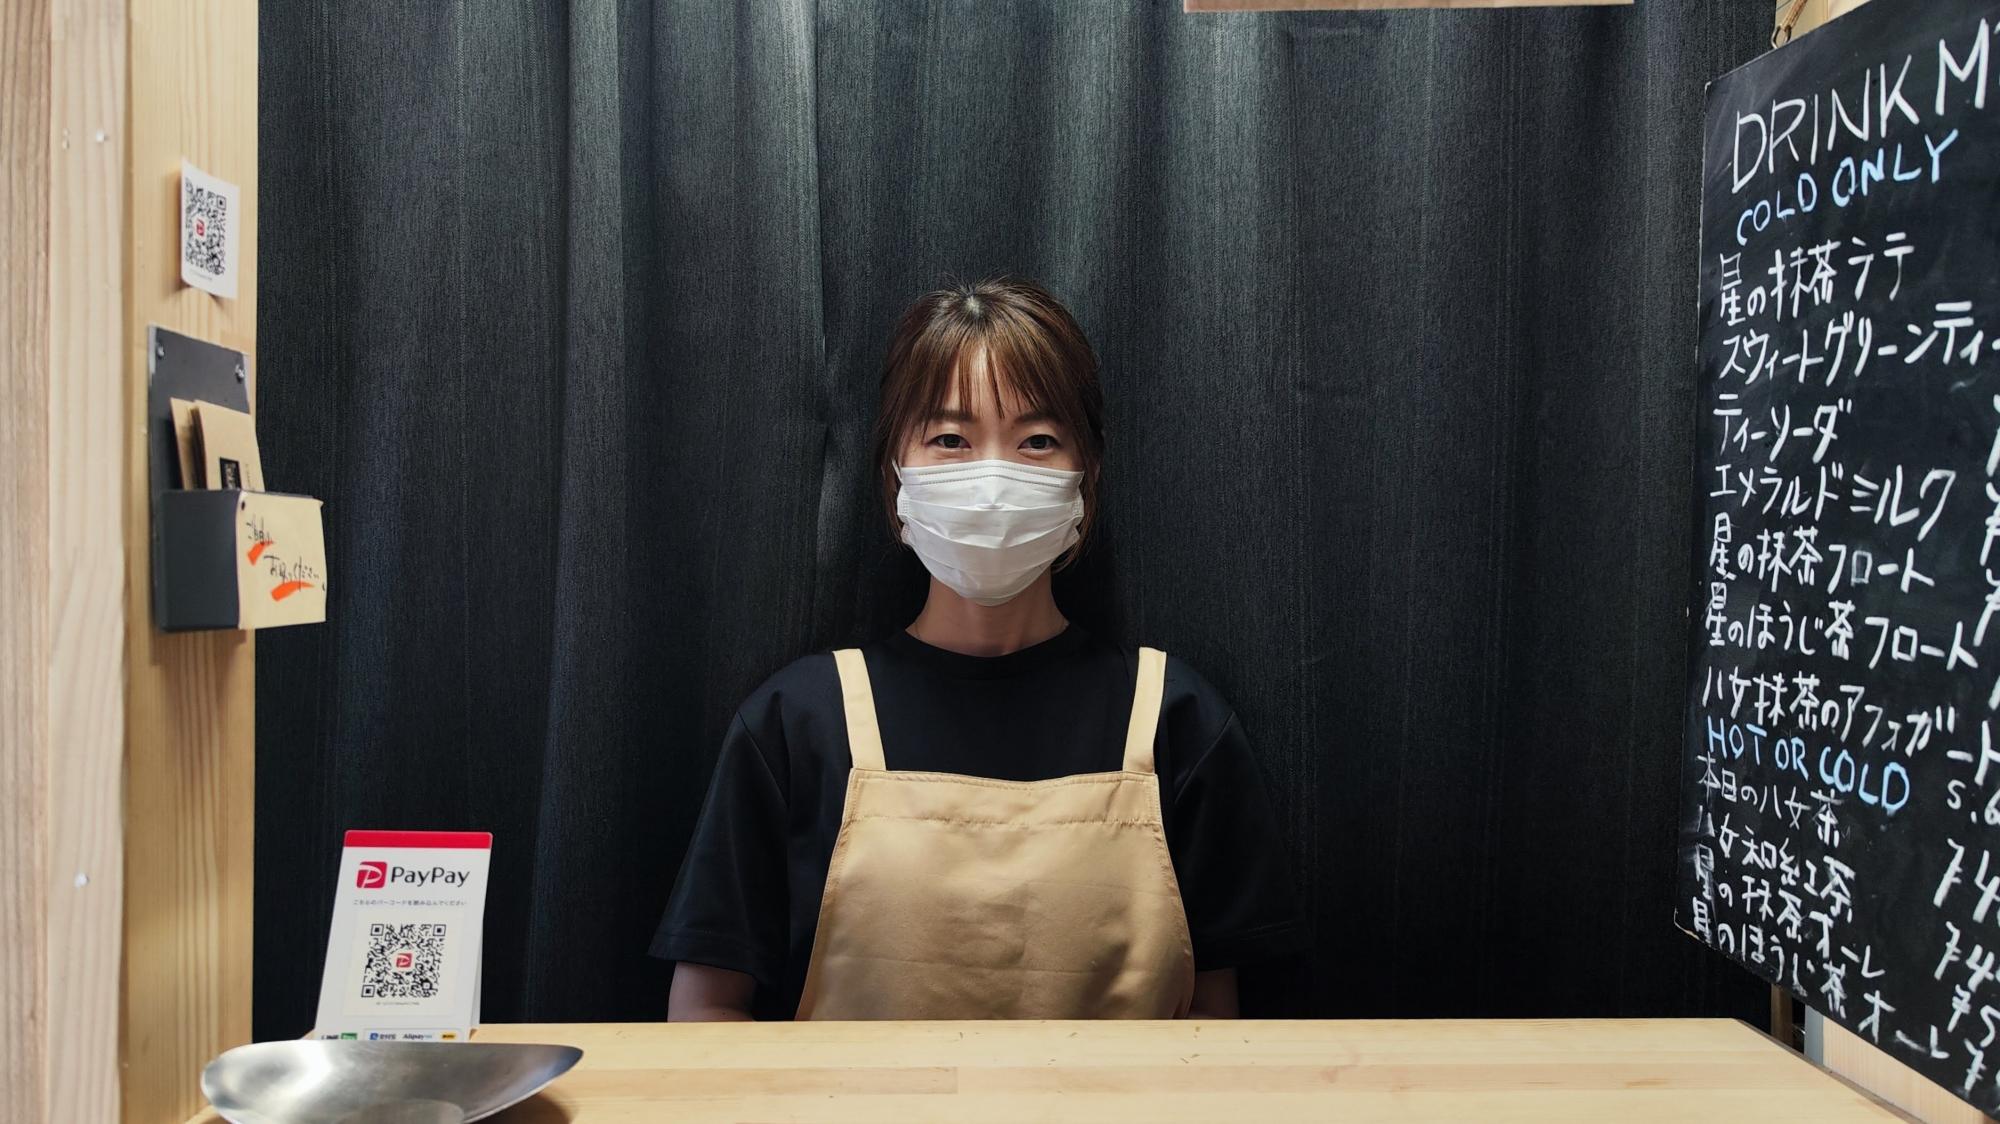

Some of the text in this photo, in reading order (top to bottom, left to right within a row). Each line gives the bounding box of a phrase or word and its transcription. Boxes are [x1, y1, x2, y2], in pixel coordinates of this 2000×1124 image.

[1732, 17, 2000, 194] DRINK M
[1736, 129, 1959, 246] COLD ONLY
[1719, 232, 1915, 326] 星の抹茶ラテ
[1719, 311, 2000, 386] スウィートグリーンティ
[1713, 394, 1852, 463] ティーソーダ
[1710, 461, 1956, 541] エメラルドミルク
[1709, 512, 1935, 593] 星の抹茶フロート
[1705, 582, 1978, 670] 星のほうじ茶フロート
[1707, 715, 1910, 812] HOT OR COLD
[390, 866, 471, 888] PayPay
